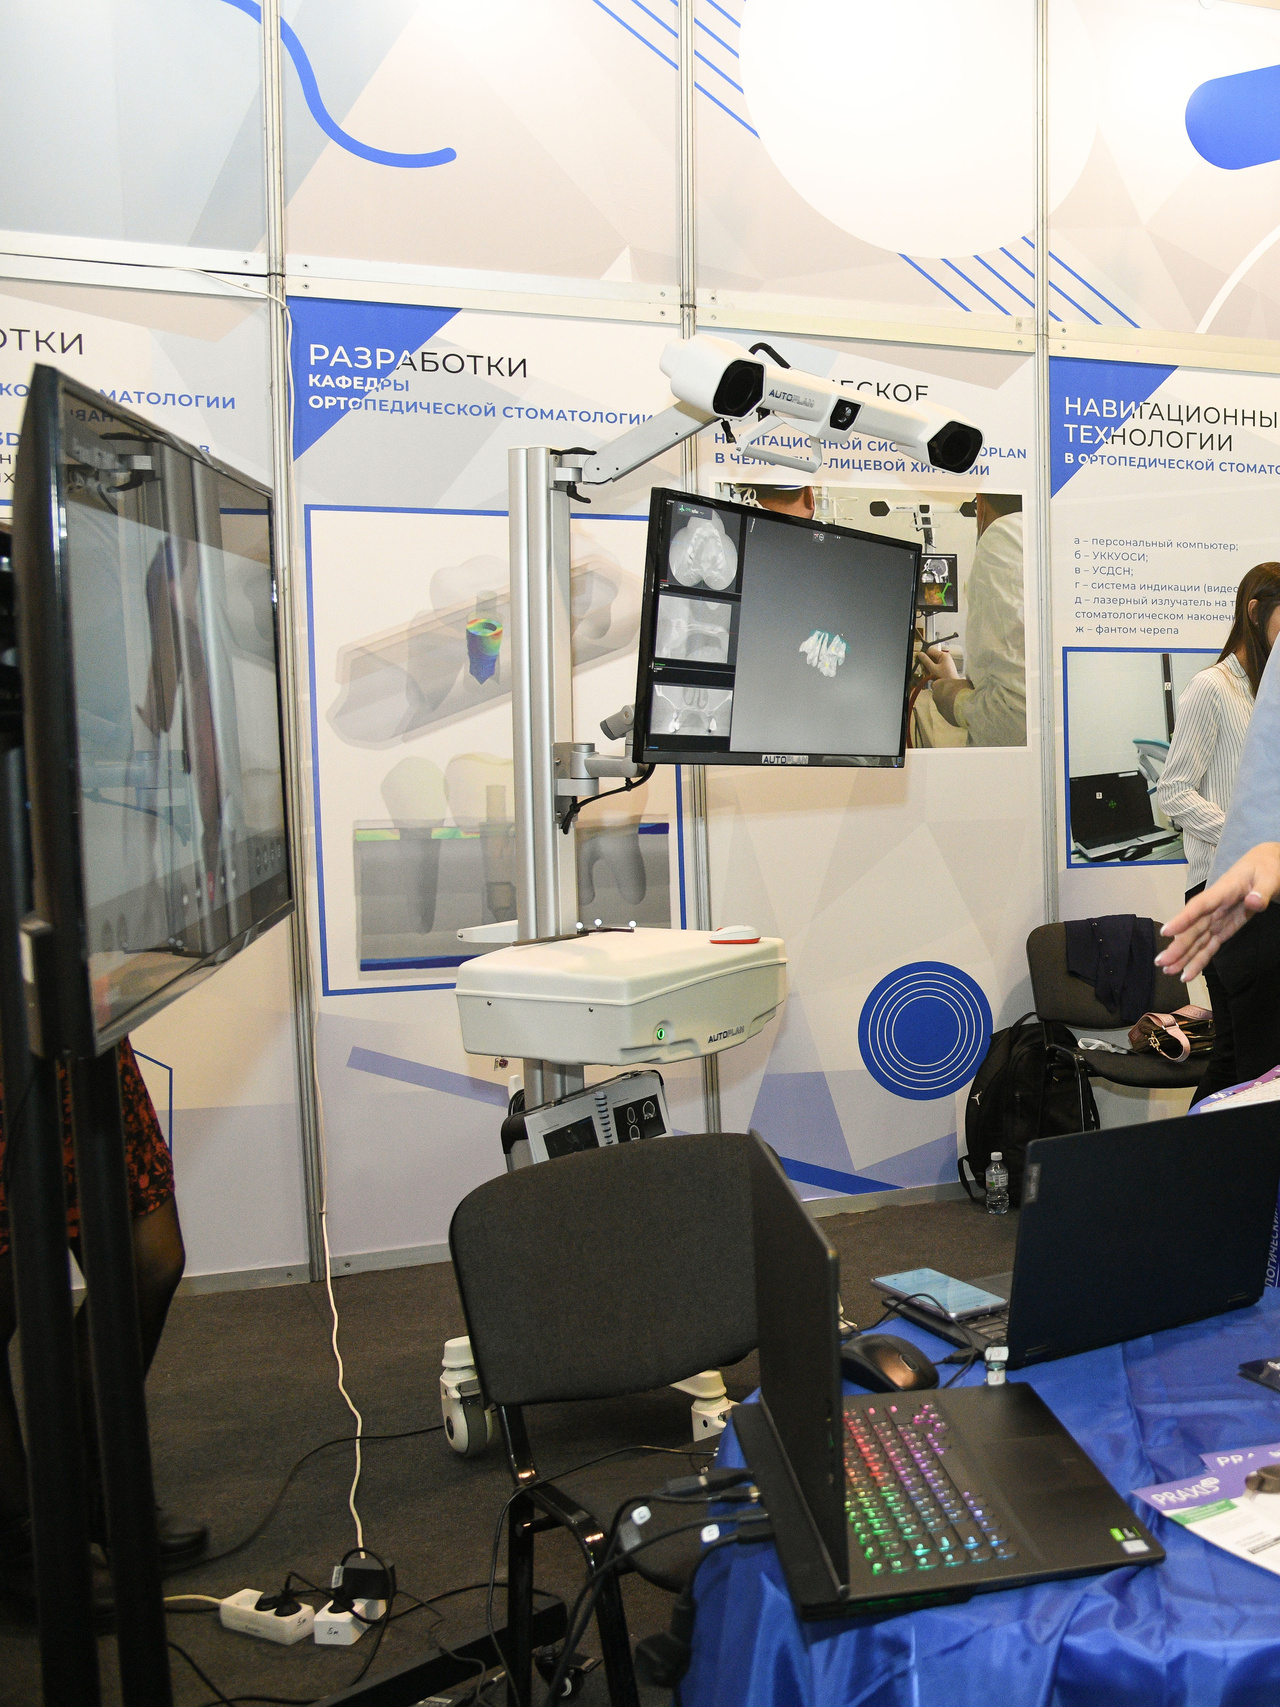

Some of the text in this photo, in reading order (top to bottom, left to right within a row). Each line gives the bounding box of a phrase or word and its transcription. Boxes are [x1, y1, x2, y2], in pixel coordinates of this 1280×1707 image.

[309, 343, 528, 379] РАЗРАБОТКИ
[308, 373, 409, 392] КАФЕДРЫ
[308, 395, 497, 418] ОРТОПЕДИЧЕСКОЙ
[1063, 423, 1233, 452] ТЕХНОЛОГИИ
[715, 452, 725, 464] В
[1064, 453, 1075, 465] В
[1078, 454, 1215, 473] ОРТОПЕДИЧЕСКОЙ
[1091, 538, 1173, 548] персональный
[1176, 541, 1239, 551] компьютер;
[1092, 551, 1149, 563] УККУОСИ;
[1092, 565, 1134, 577] УСДСН;
[1091, 581, 1137, 591] система
[1139, 583, 1201, 593] индикации
[1093, 596, 1148, 606] лазерный
[1151, 598, 1212, 608] излучатель
[1075, 610, 1184, 621] стоматологическом
[1095, 624, 1137, 635] фантом
[1139, 626, 1179, 635] черепа
[708, 1025, 745, 1044] AUTOPLAN
